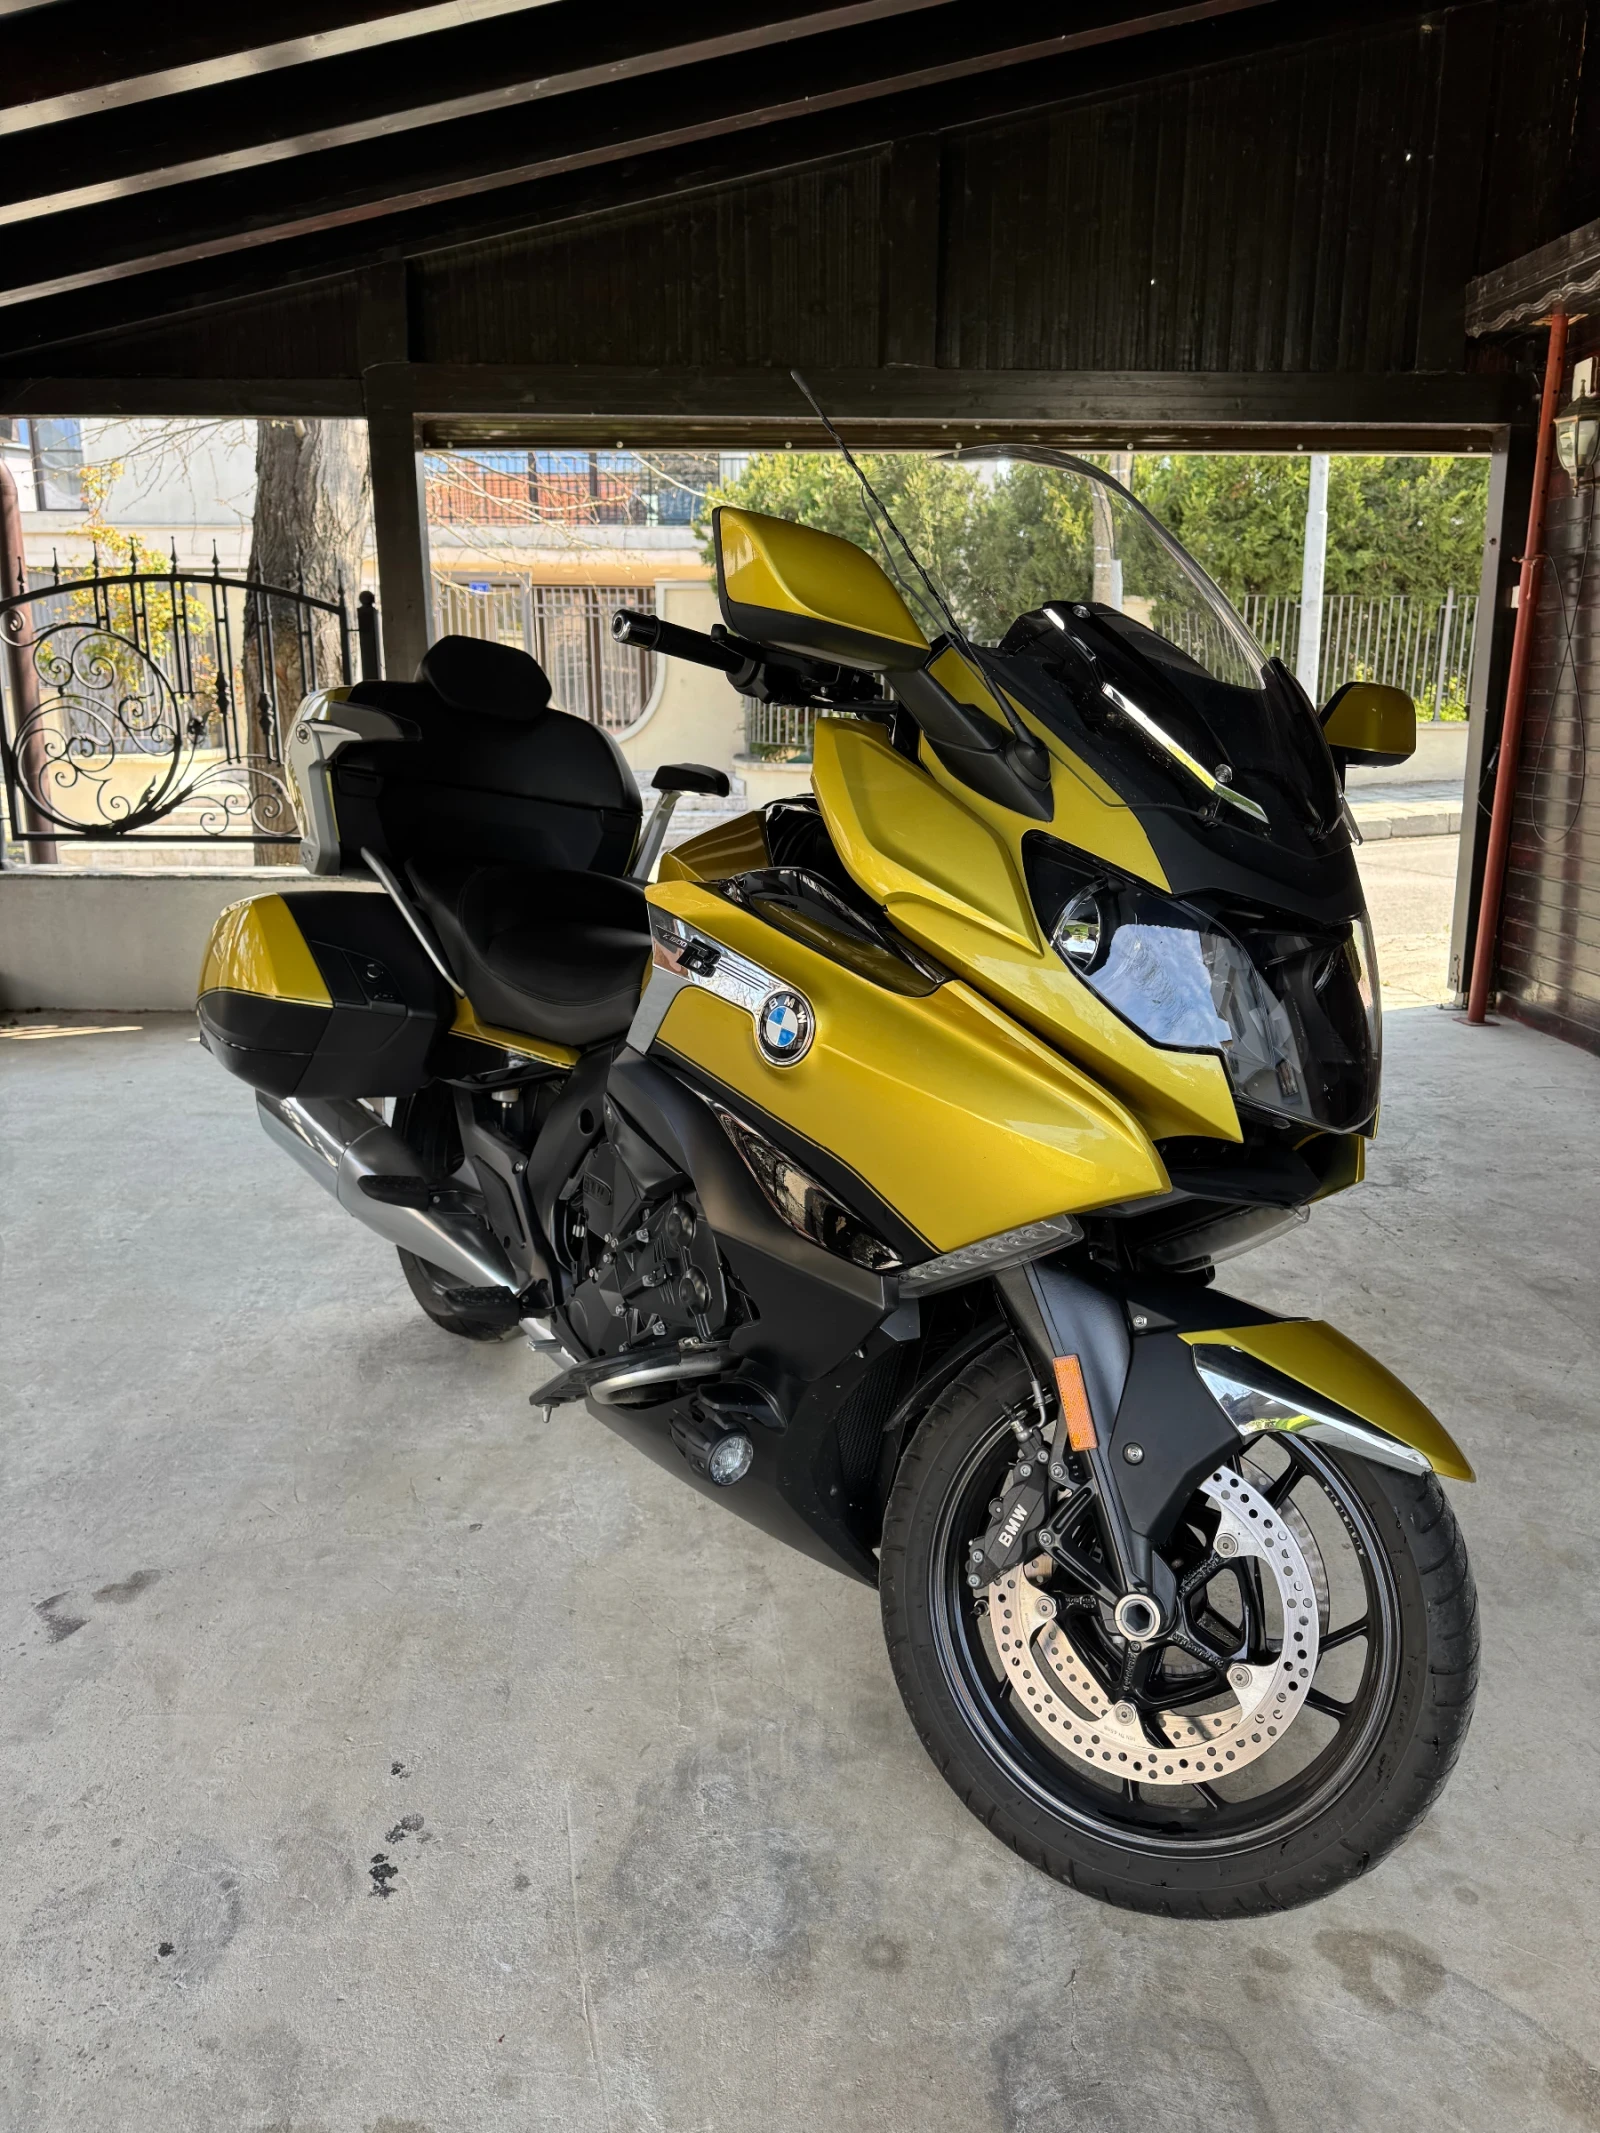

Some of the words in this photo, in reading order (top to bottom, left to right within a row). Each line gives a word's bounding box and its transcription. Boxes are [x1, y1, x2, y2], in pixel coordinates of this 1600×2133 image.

[669, 935, 688, 948] 1600
[768, 996, 808, 1025] BMW
[998, 1503, 1028, 1548] BMW
